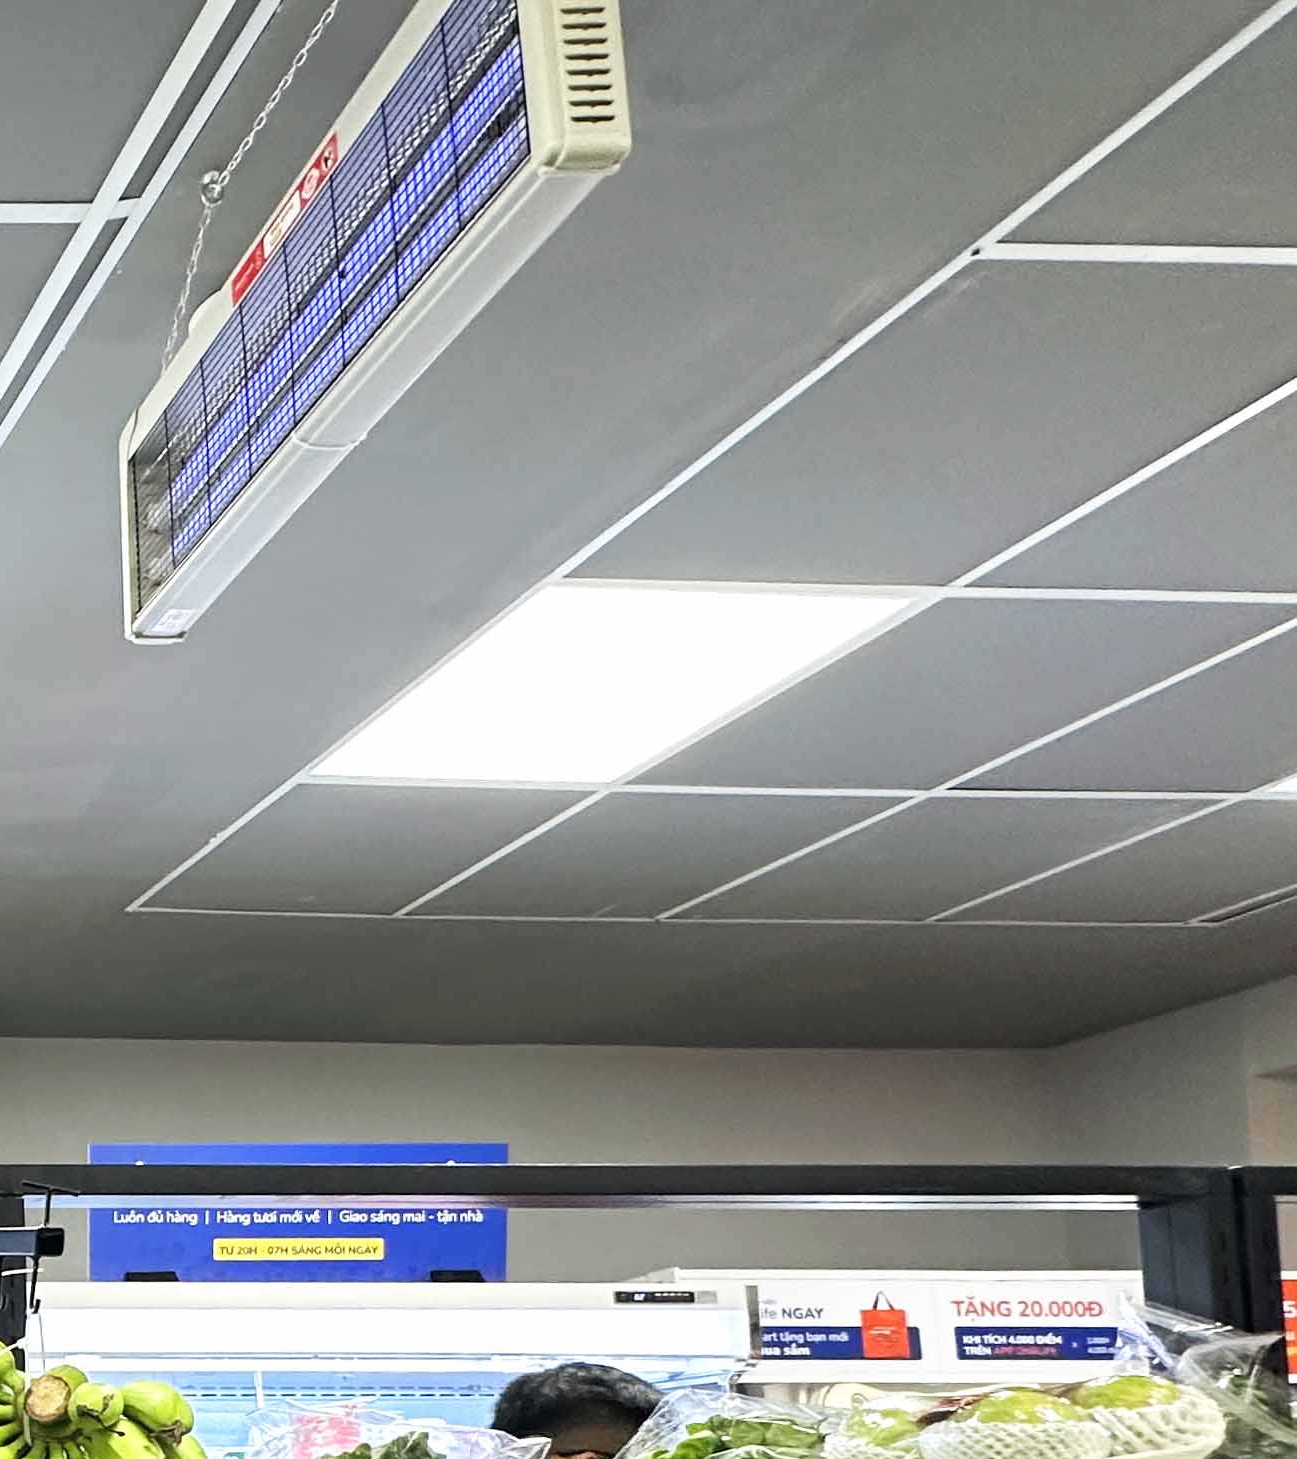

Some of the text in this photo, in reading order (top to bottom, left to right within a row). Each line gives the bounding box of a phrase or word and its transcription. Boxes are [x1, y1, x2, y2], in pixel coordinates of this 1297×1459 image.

[166, 1209, 198, 1226] hàng
[216, 1210, 251, 1226] Hàng
[339, 1210, 368, 1223] Giao
[370, 1209, 400, 1226] sáng
[402, 1210, 426, 1223] mai
[459, 1210, 484, 1223] nhà
[781, 1308, 823, 1319] NGAY
[950, 1296, 1103, 1322] TẶNG 20.000Đ
